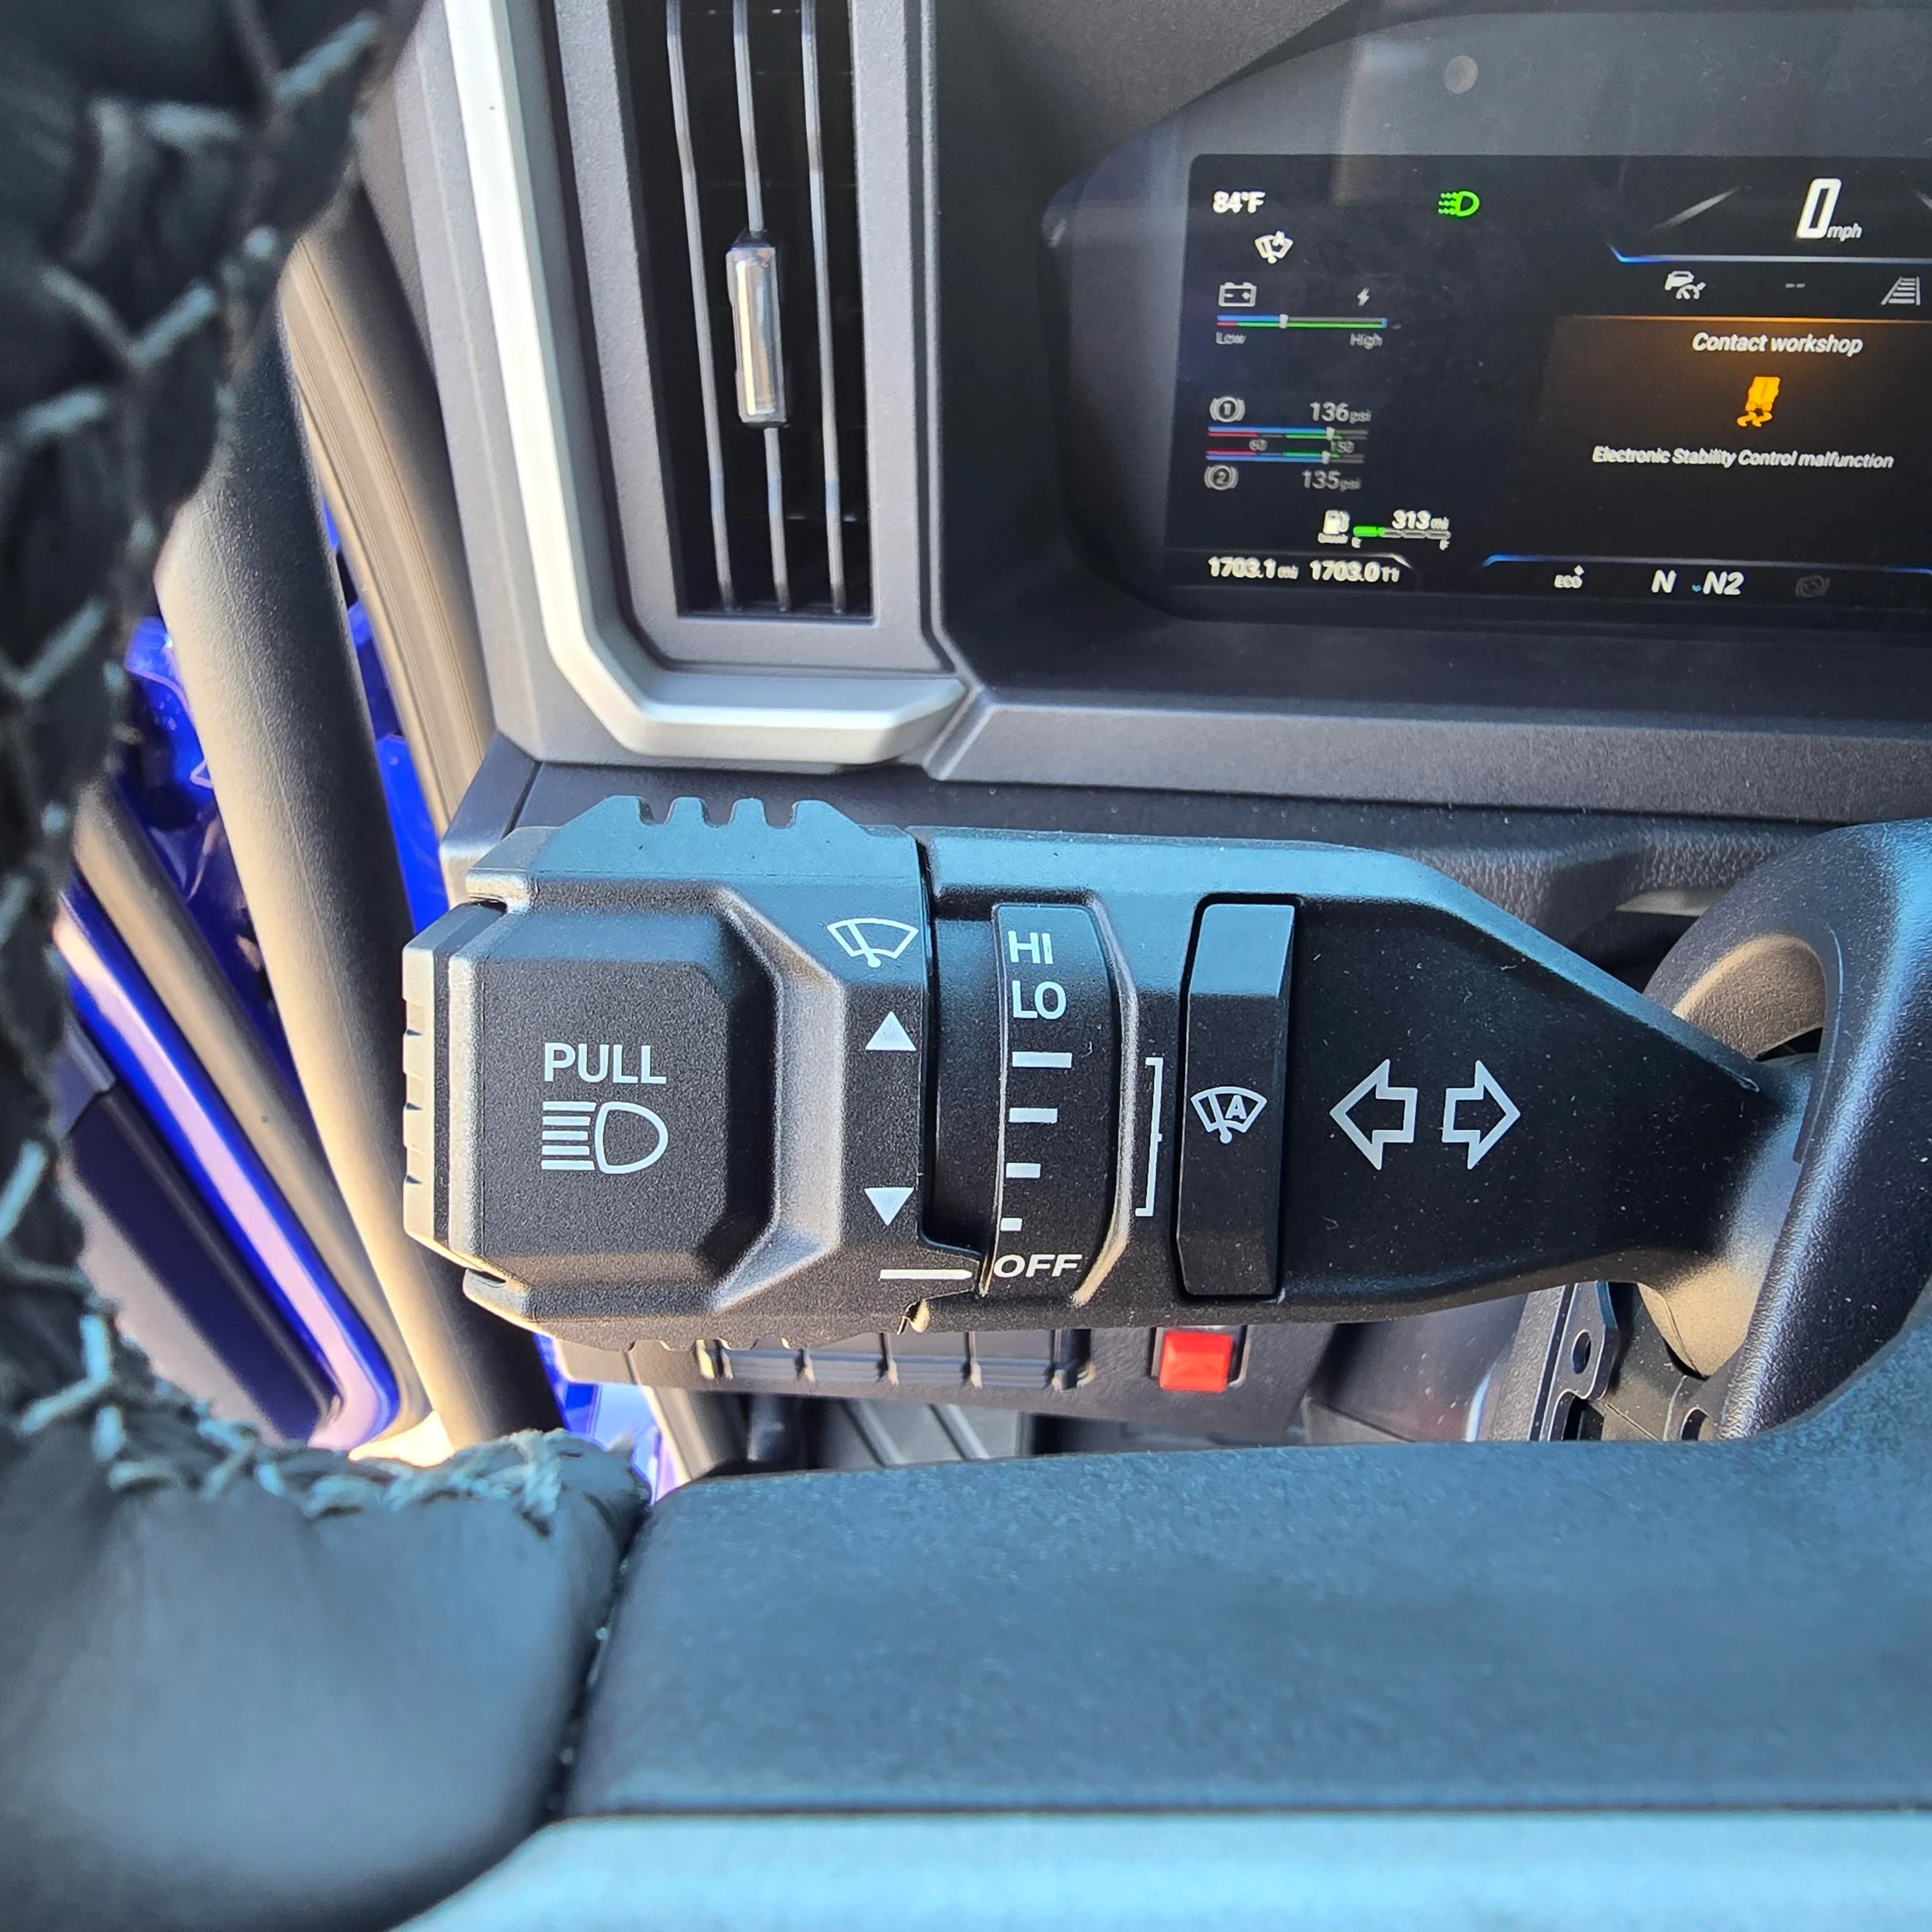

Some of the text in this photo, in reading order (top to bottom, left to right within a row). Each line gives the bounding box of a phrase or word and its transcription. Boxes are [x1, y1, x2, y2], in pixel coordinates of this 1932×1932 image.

[1213, 190, 1266, 213] 84°F
[1796, 178, 1862, 242] 0 mph
[1216, 332, 1246, 345] Low
[1350, 333, 1383, 349] High
[1692, 332, 1864, 357] Contact workshop
[1592, 446, 1894, 468] Electronic Stability Control malfunction
[1651, 570, 1677, 593] N
[1008, 930, 1053, 965] HI
[1012, 980, 1067, 1020] LO
[542, 1042, 667, 1085] PULL
[992, 1253, 1083, 1279] OFF
